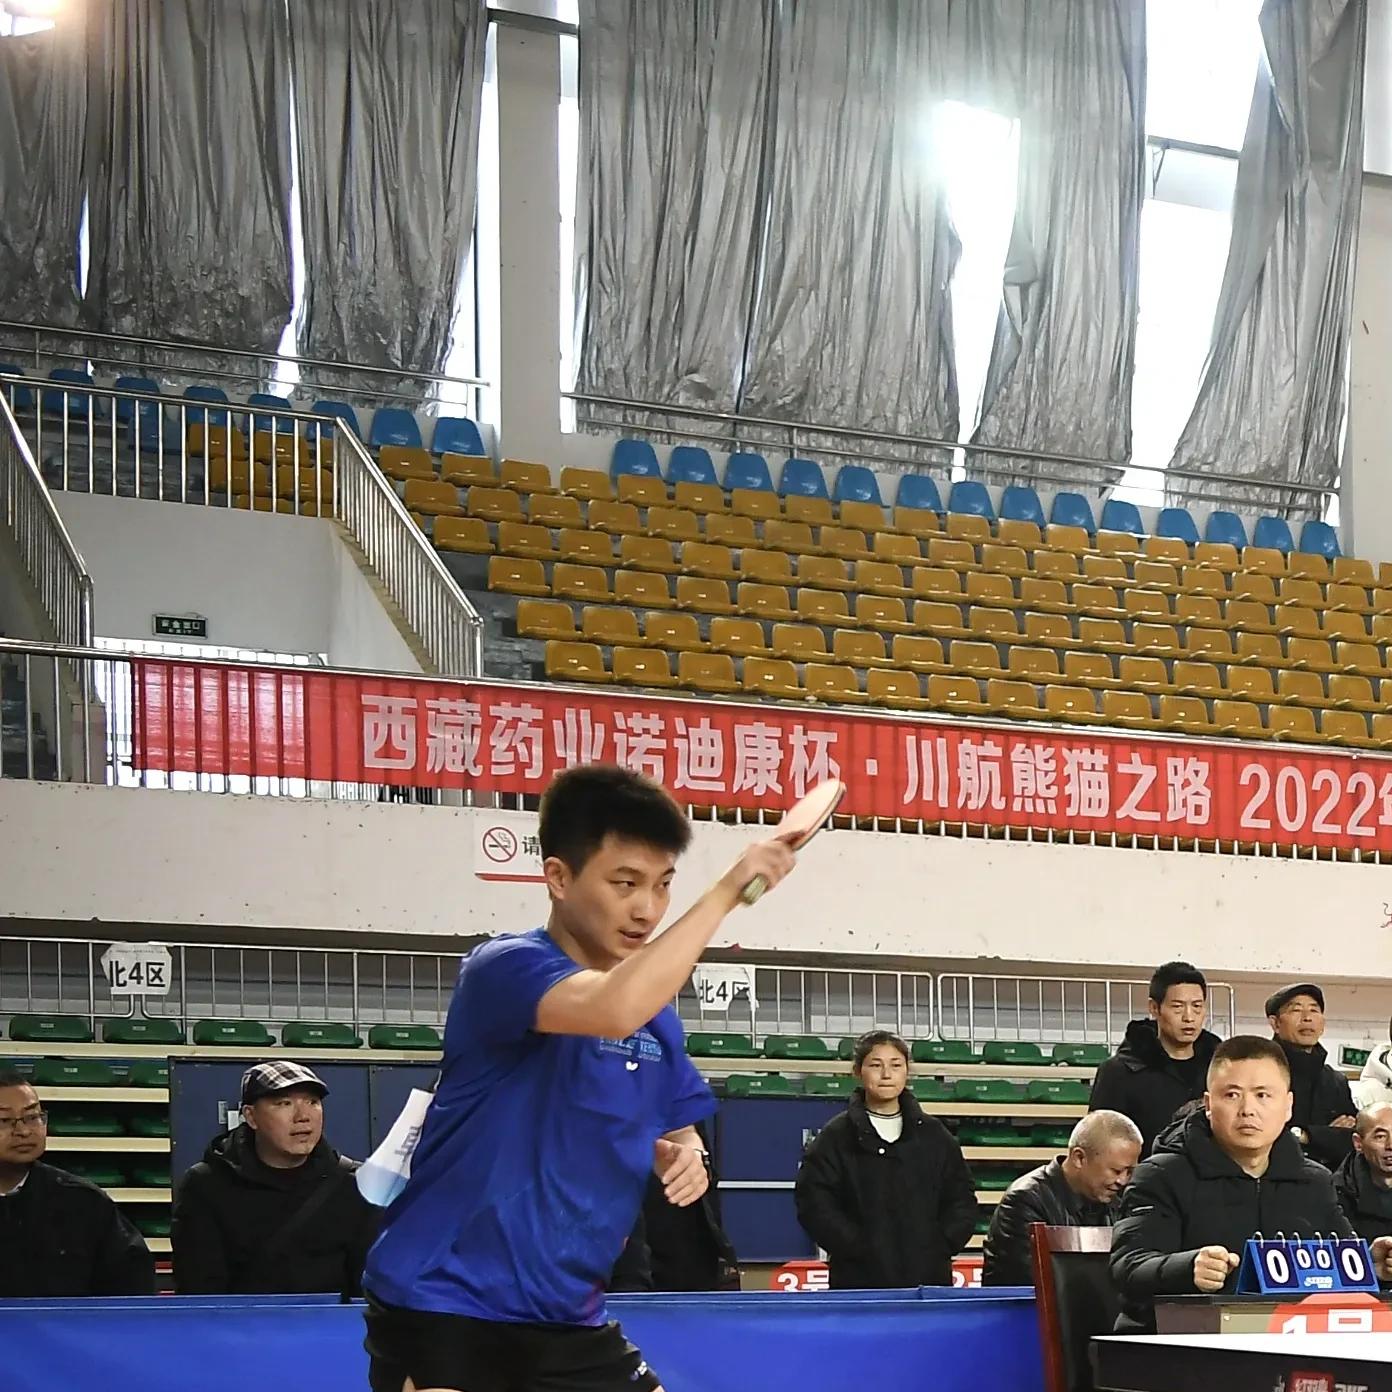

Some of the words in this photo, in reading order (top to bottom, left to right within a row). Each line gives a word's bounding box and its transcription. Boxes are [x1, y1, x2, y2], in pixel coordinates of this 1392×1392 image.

[1266, 1249, 1290, 1284] 0
[1296, 1248, 1311, 1269] 0
[1316, 1248, 1331, 1270] 0
[1341, 1247, 1364, 1282] 0
